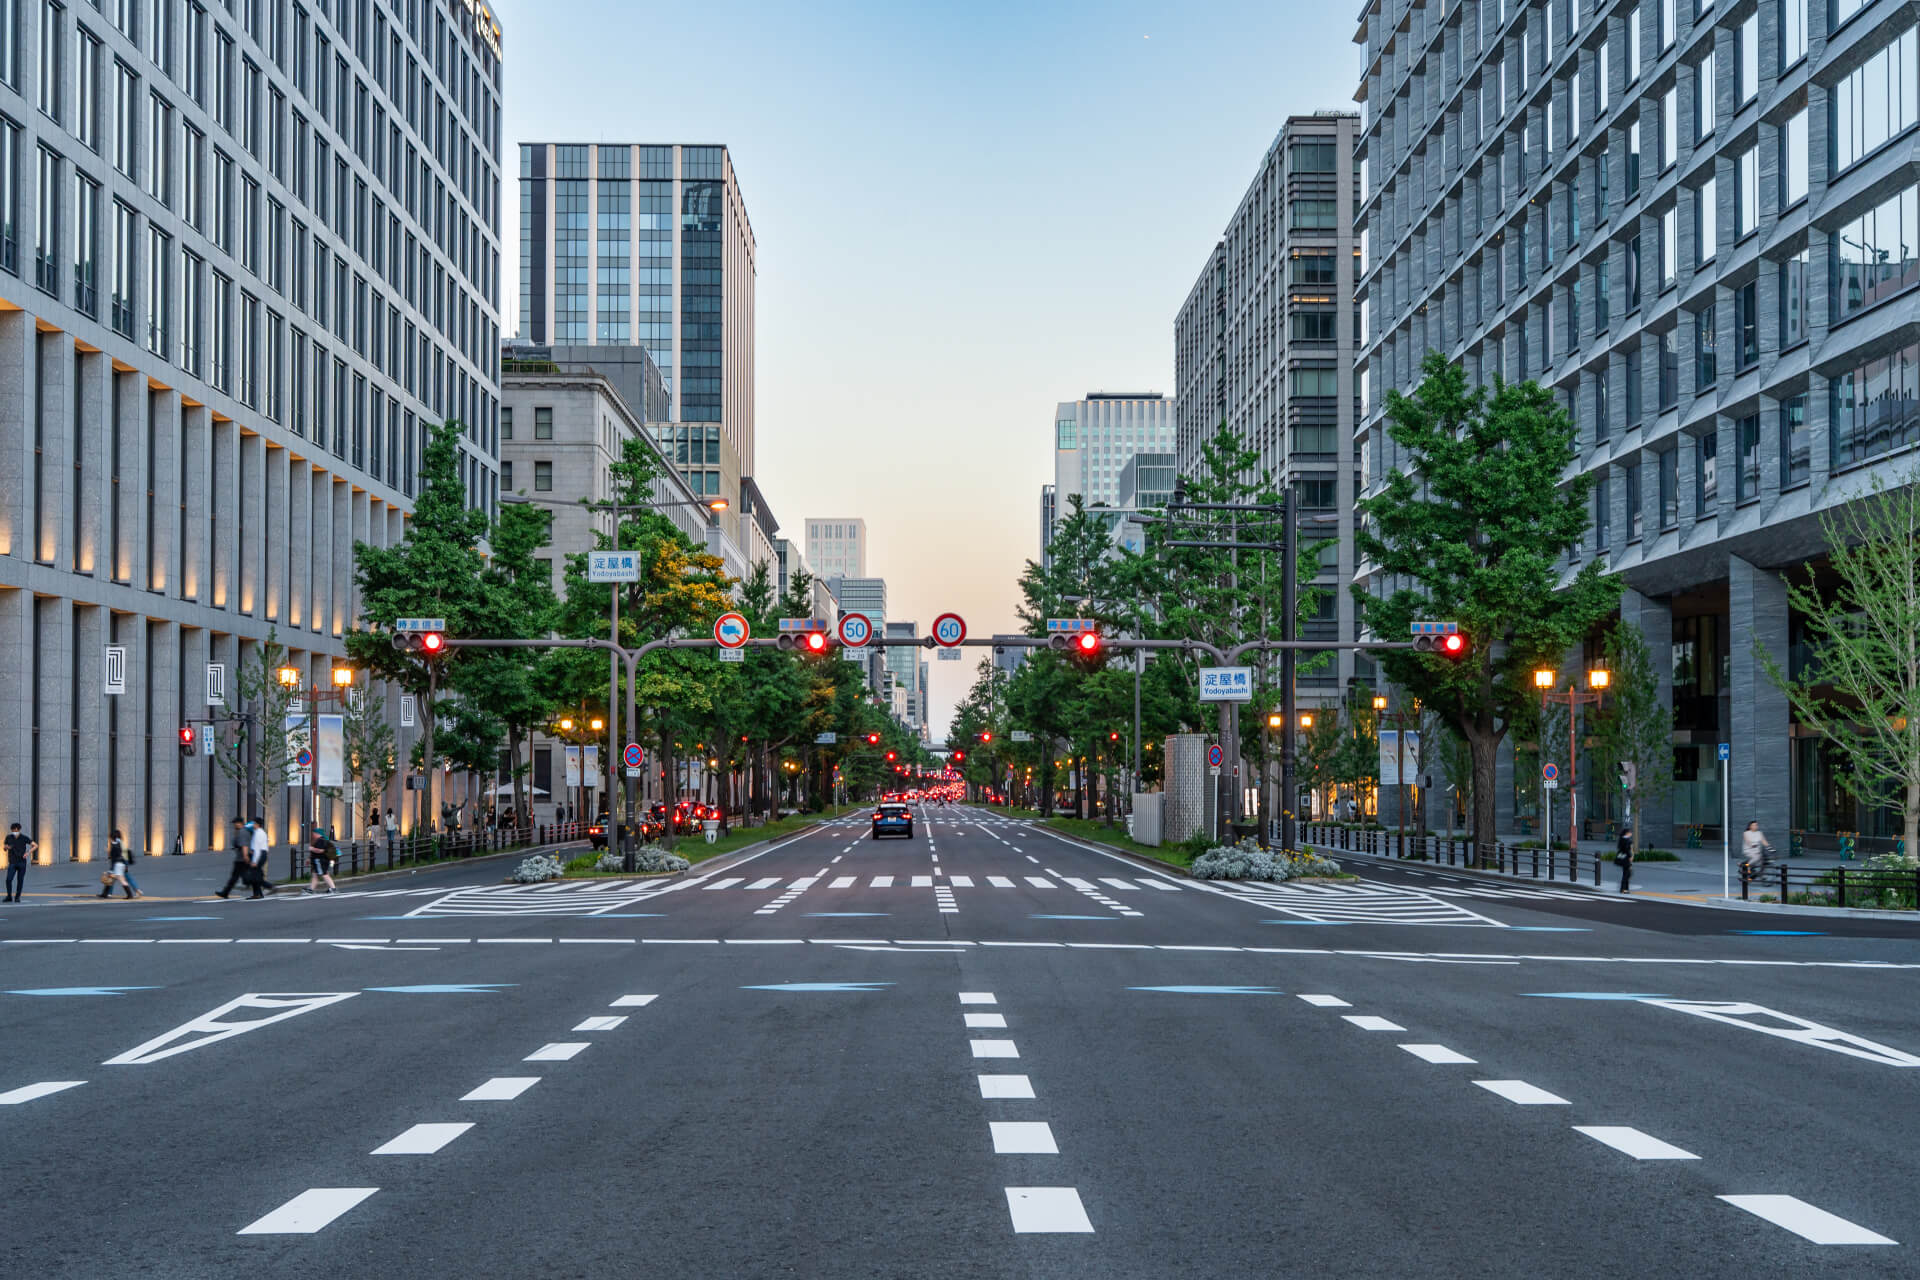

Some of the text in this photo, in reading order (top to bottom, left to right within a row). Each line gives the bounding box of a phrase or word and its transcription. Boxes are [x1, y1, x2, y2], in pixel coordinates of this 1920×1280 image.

[594, 556, 633, 569] 淀屋橋
[846, 622, 865, 638] 50
[940, 622, 959, 638] 60
[1205, 672, 1247, 686] 淀屋橋
[1204, 687, 1248, 695] Yodoyabashi
